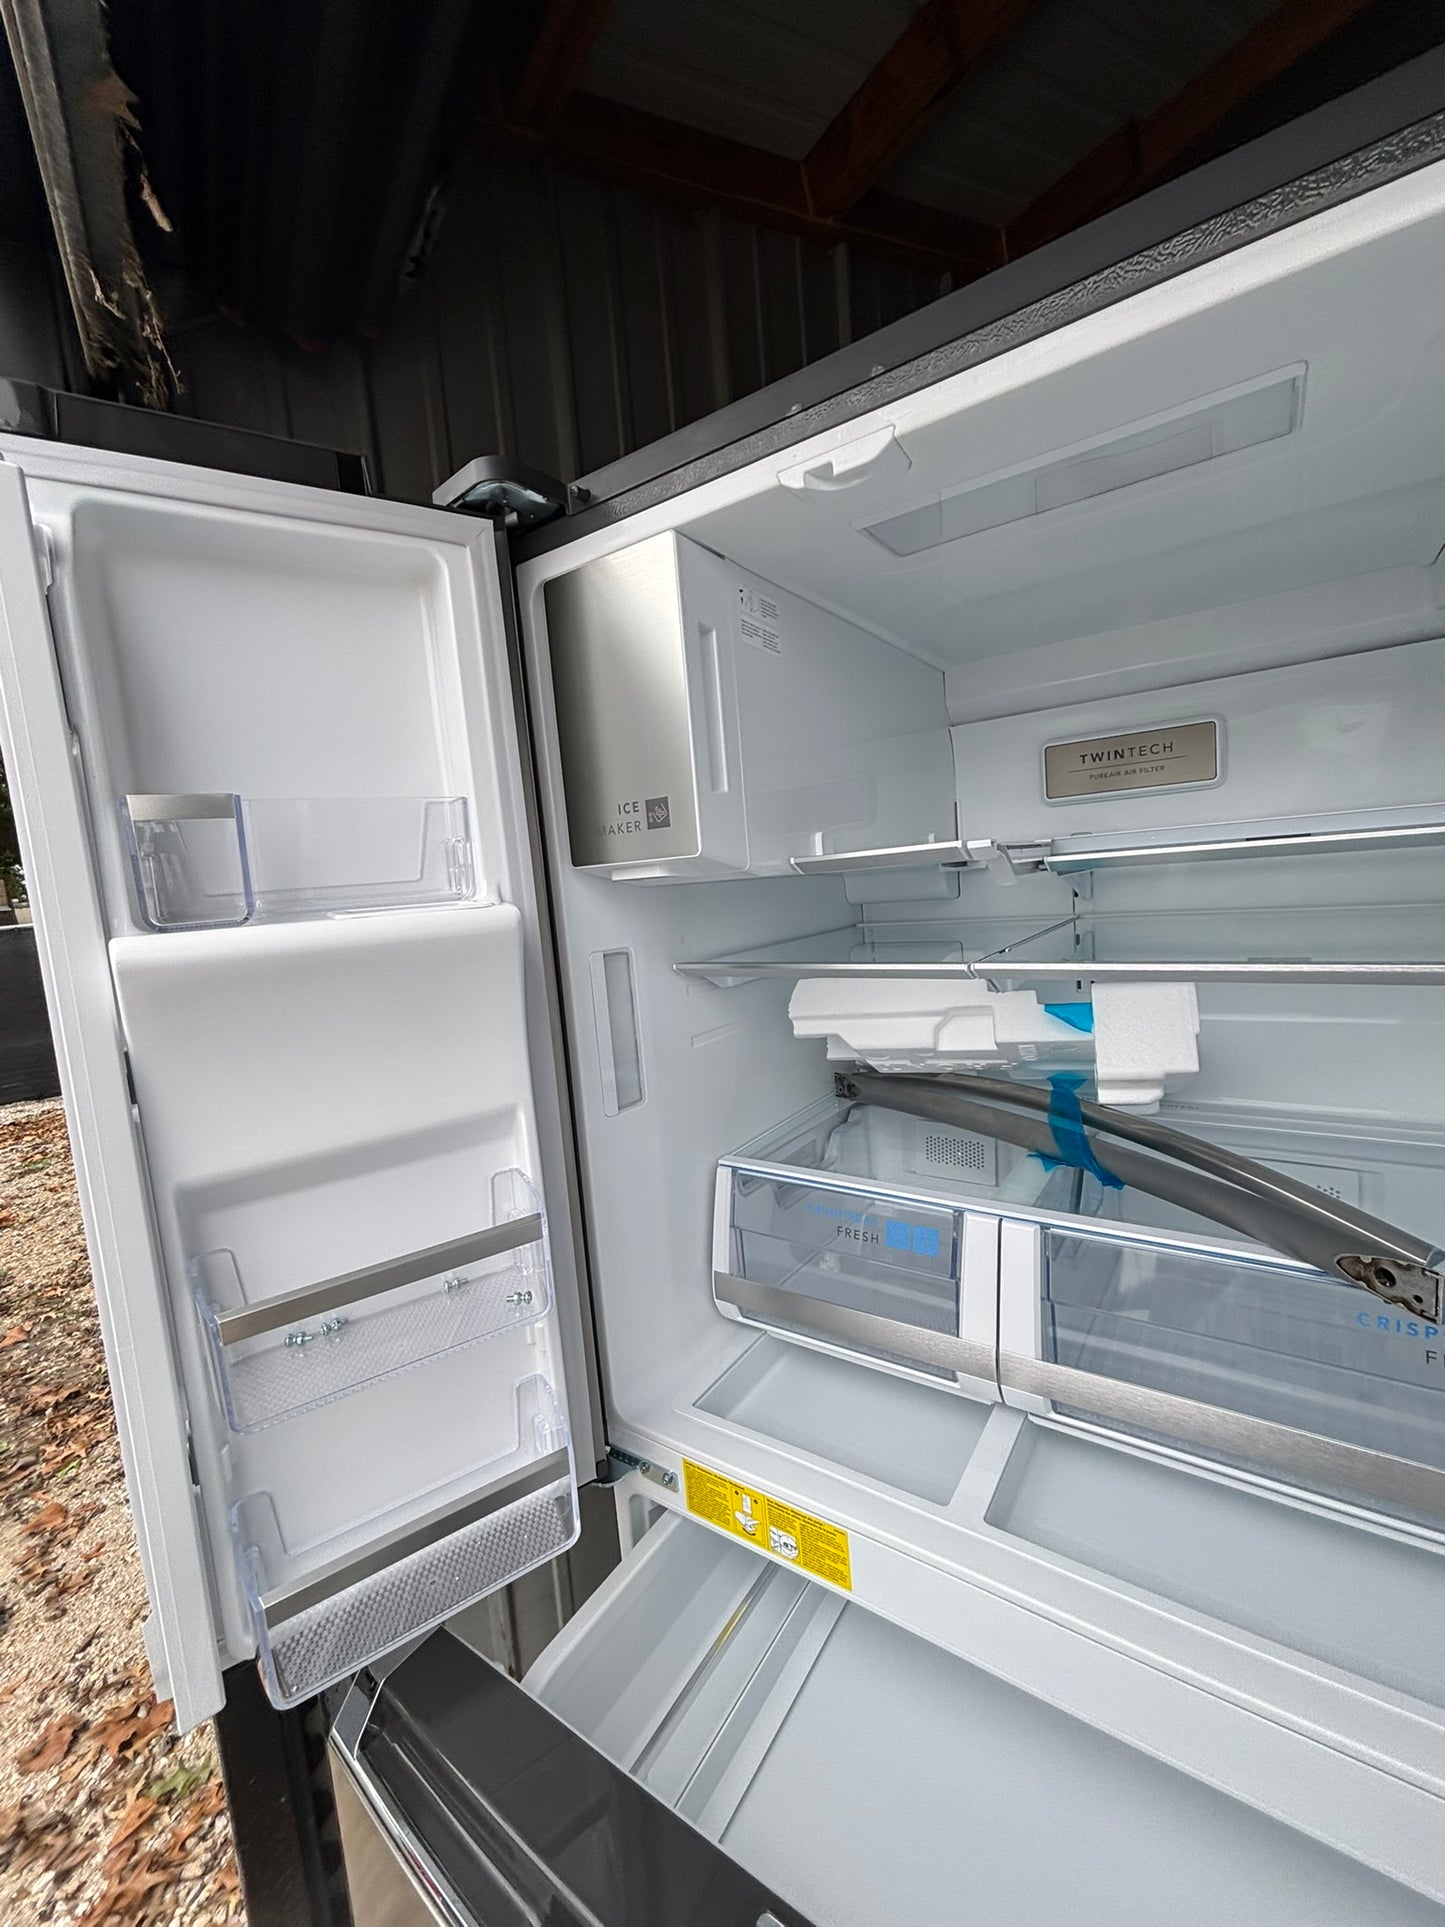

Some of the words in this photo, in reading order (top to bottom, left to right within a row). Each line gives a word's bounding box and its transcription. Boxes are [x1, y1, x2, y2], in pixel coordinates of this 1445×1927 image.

[1080, 742, 1173, 764] TWINTECH
[1123, 768, 1137, 777] AIR
[1138, 765, 1166, 775] FILTER
[617, 801, 640, 815] ICE
[836, 1225, 880, 1245] FRESH
[1356, 1312, 1445, 1338] CRISP
[1425, 1349, 1445, 1368] F
